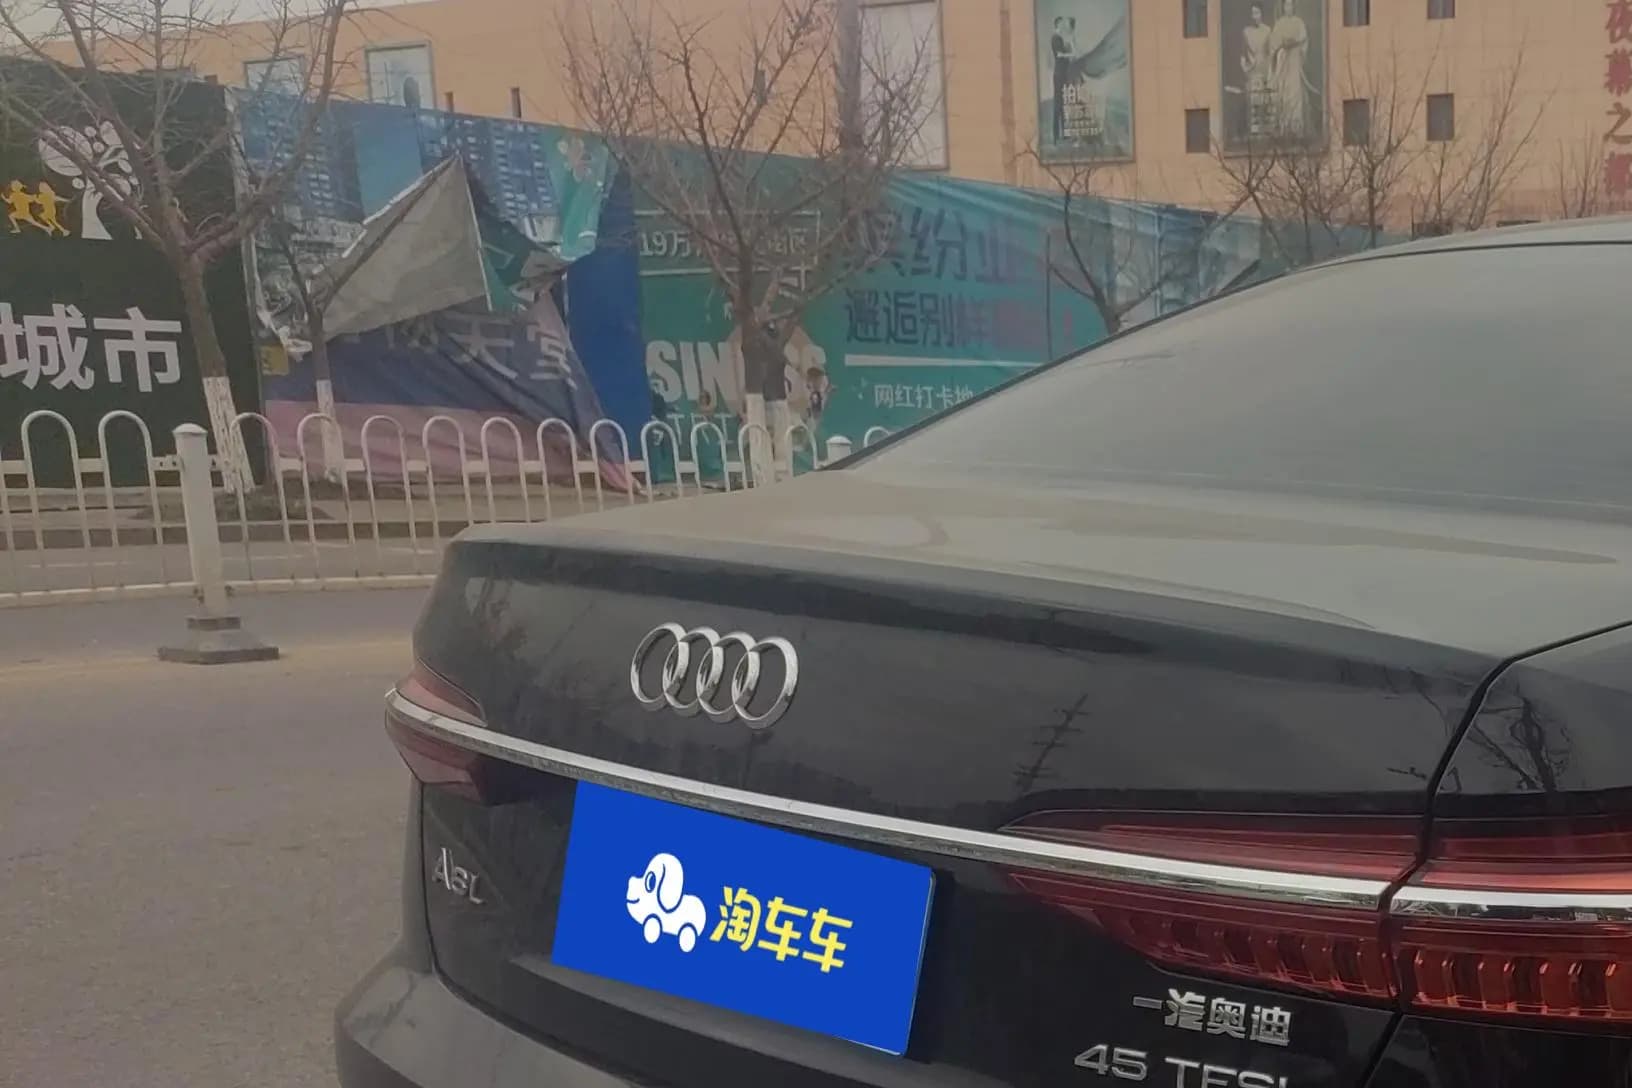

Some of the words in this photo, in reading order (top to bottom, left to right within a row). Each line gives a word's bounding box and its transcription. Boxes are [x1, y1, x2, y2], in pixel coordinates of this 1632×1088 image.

[432, 847, 483, 904] A6L
[1132, 988, 1292, 1047] 一汽奥迪
[1074, 1044, 1148, 1081] 45
